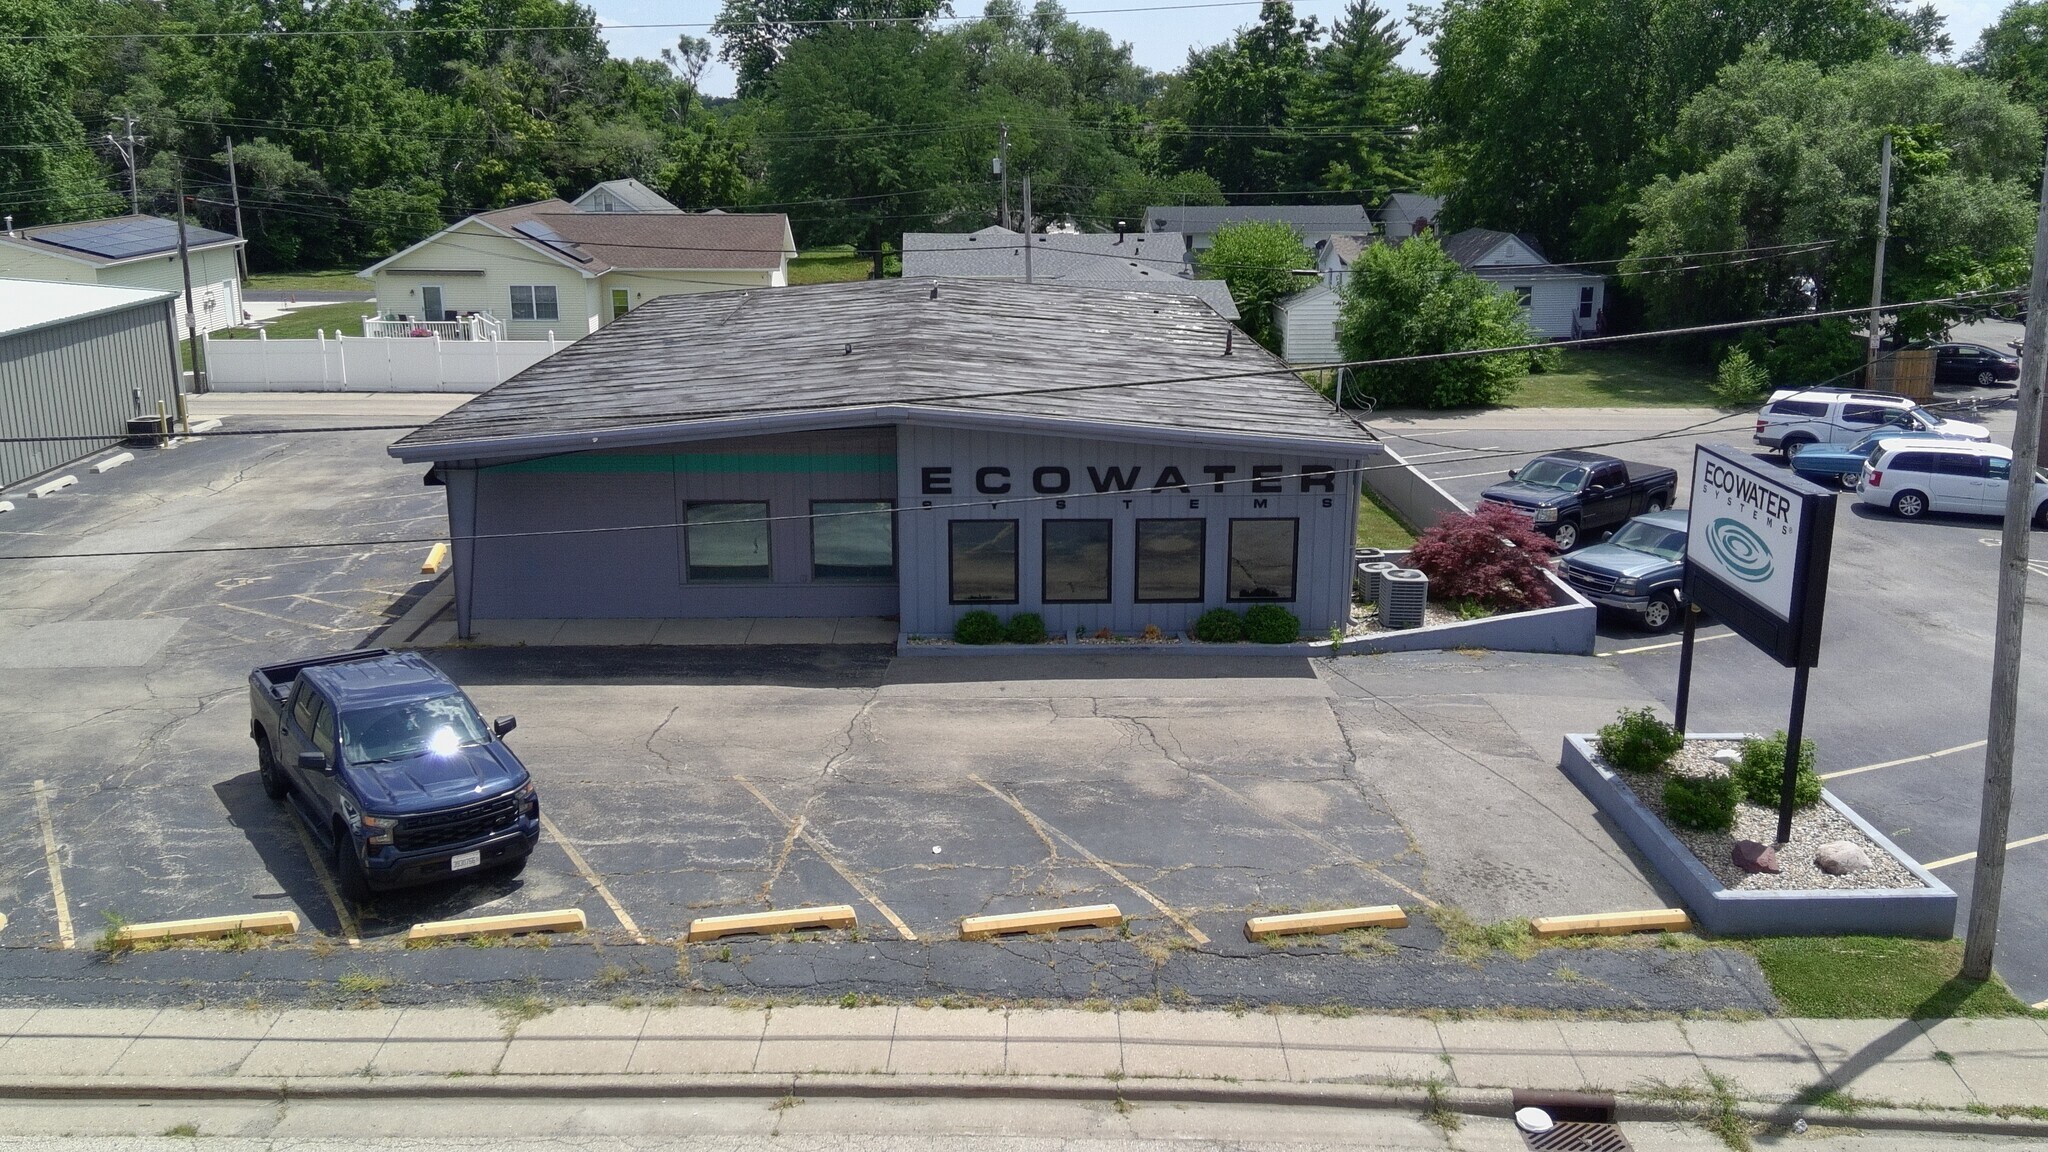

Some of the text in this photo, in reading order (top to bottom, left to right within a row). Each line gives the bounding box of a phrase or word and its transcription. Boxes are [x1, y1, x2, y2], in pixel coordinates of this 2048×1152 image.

[922, 465, 1335, 495] ECOWATER
[1704, 461, 1790, 523] ECOWATER
[922, 498, 1333, 510] SYSTEMS
